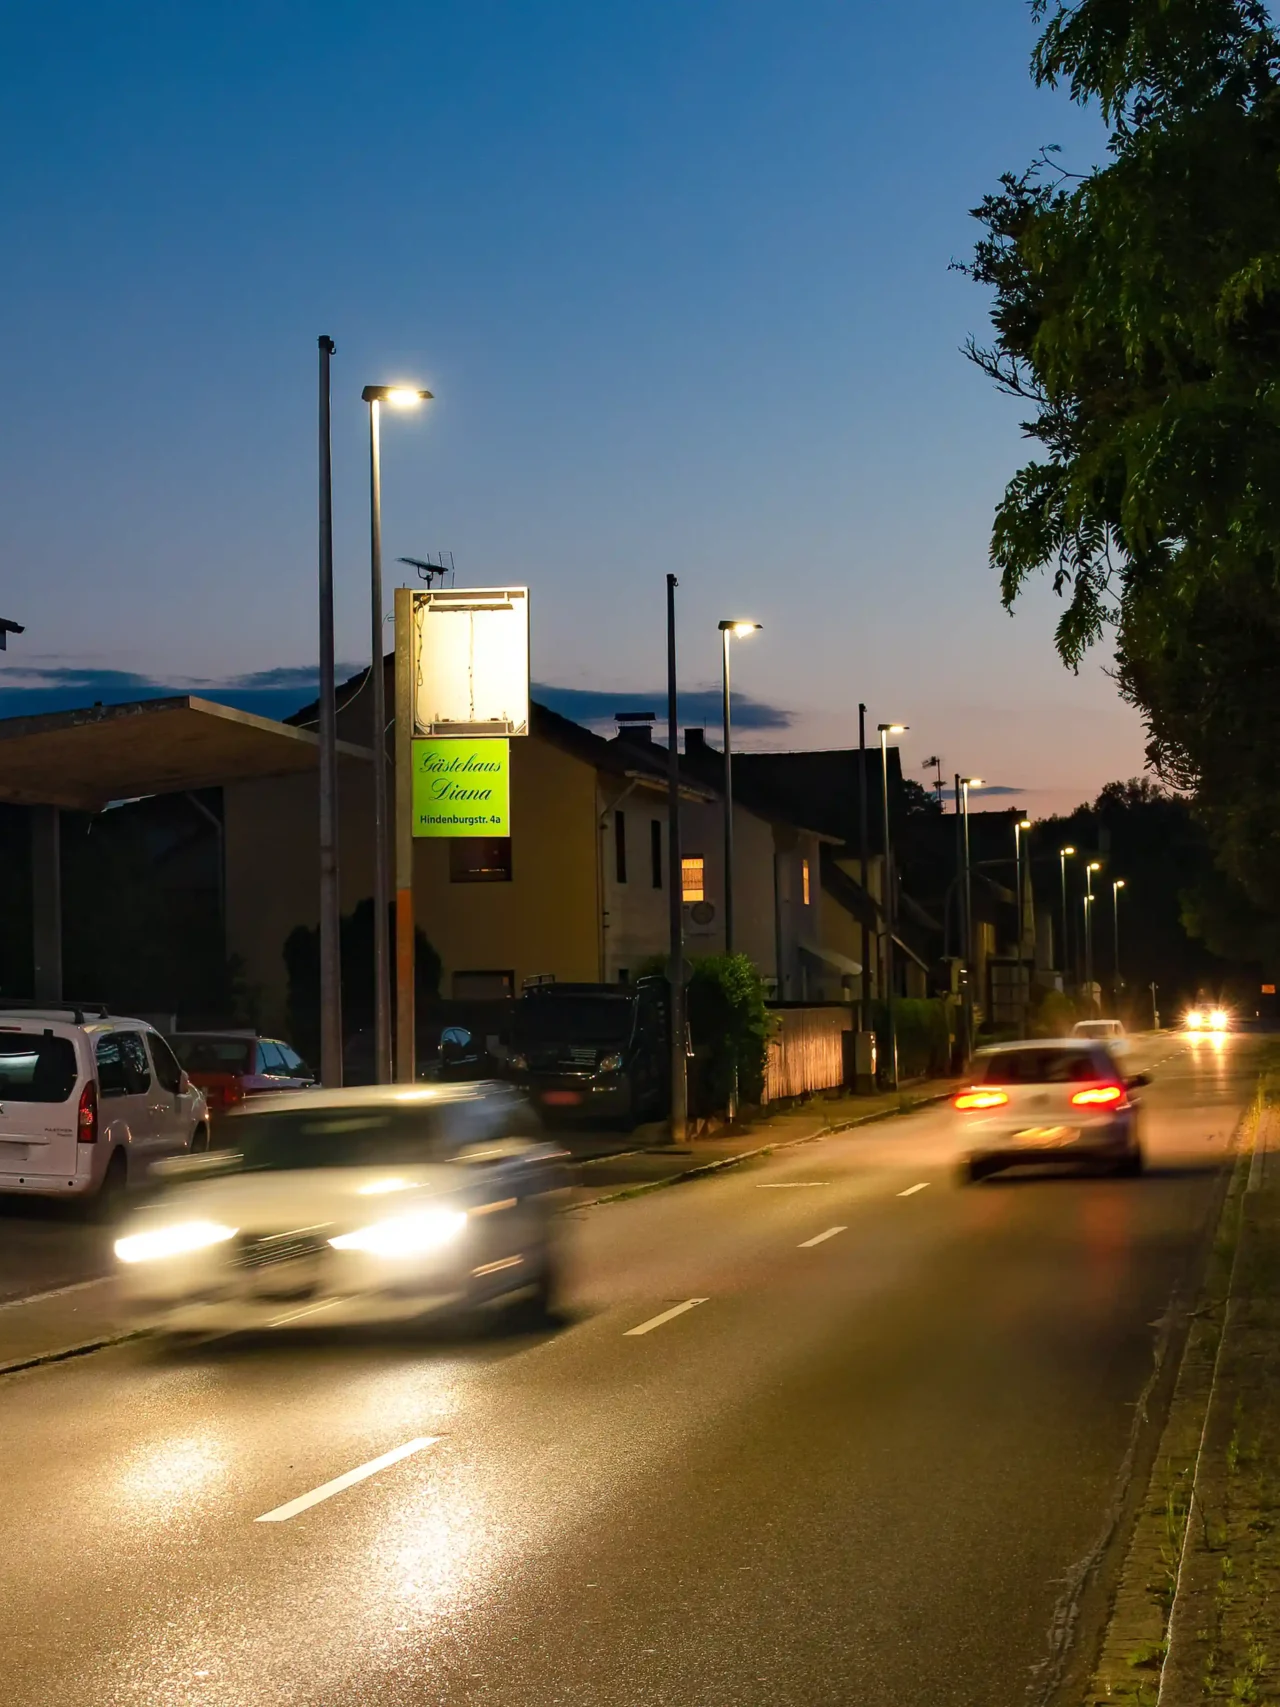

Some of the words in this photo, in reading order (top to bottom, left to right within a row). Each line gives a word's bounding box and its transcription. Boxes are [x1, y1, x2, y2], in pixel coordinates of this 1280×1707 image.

[419, 751, 502, 773] Gästehaus
[429, 777, 492, 802] Diana
[419, 814, 488, 826] Hindenburgstr.
[489, 815, 501, 824] 4a
